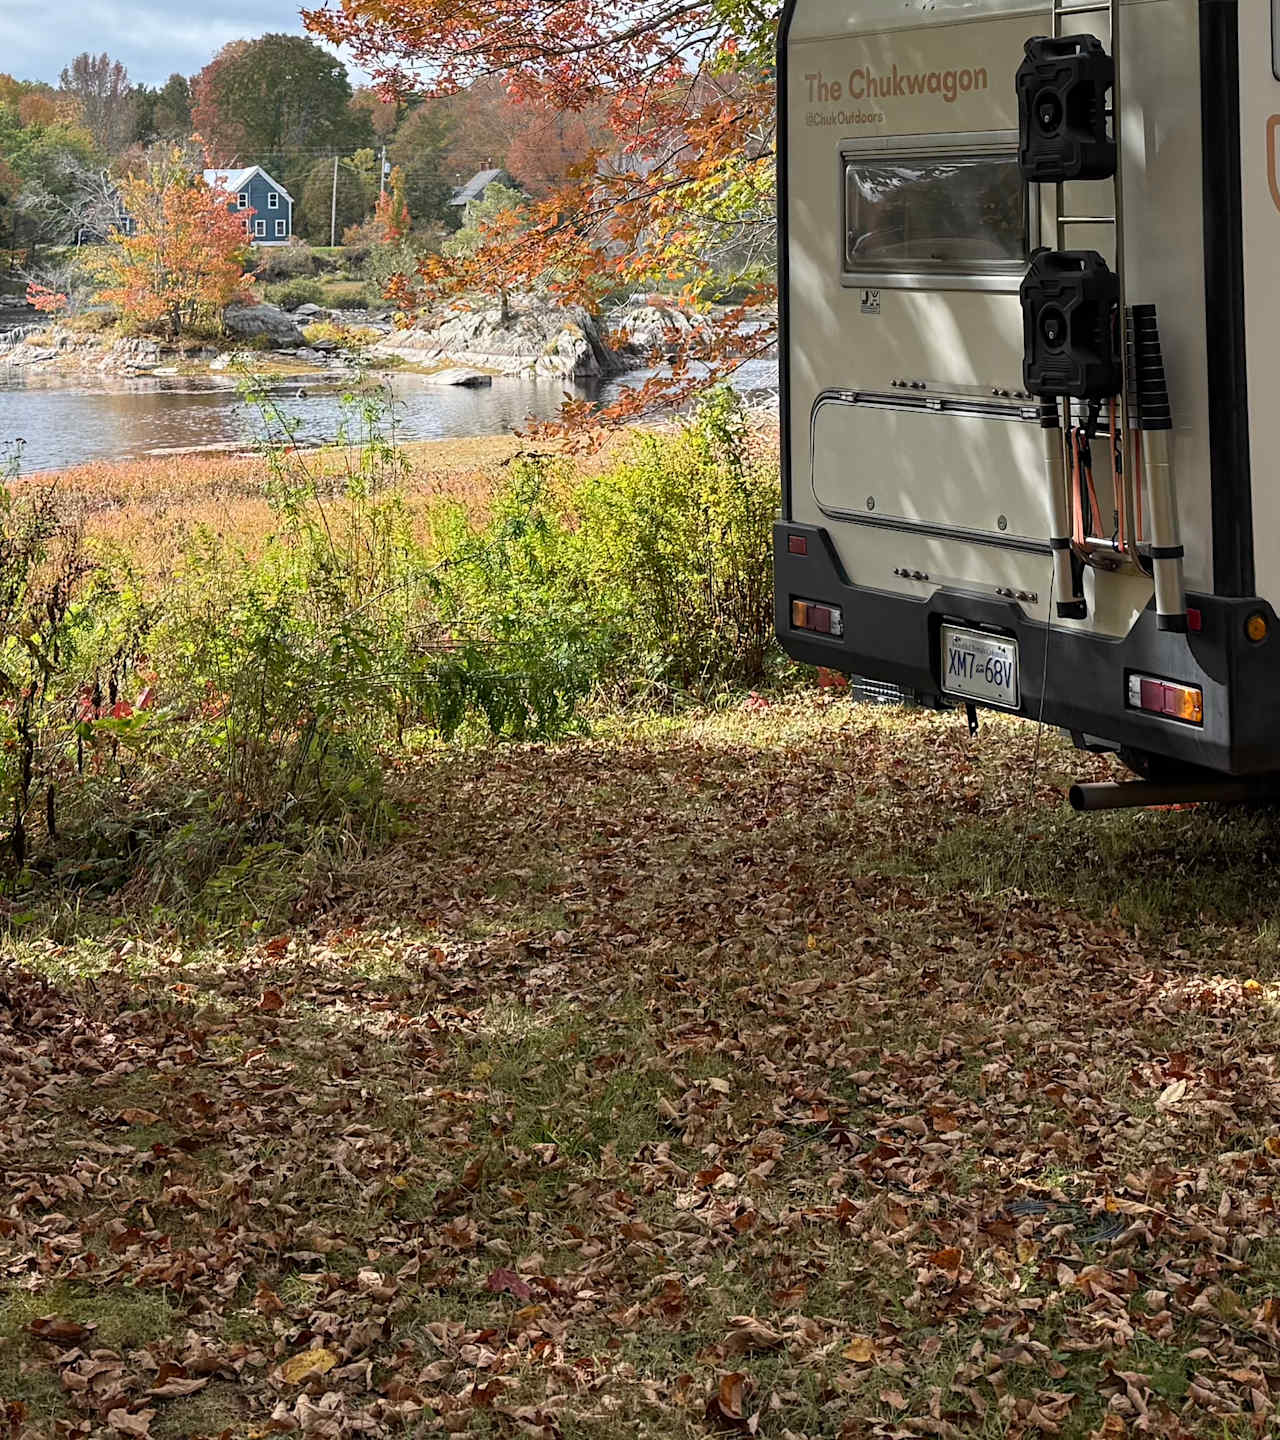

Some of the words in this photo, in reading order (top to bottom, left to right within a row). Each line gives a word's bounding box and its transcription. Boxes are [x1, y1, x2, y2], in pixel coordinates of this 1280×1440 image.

[805, 71, 842, 103] The
[849, 64, 988, 102] Chukwagon
[806, 110, 884, 127] @ChukOutdoors
[948, 647, 976, 680] XM7
[985, 657, 1012, 689] 68V
